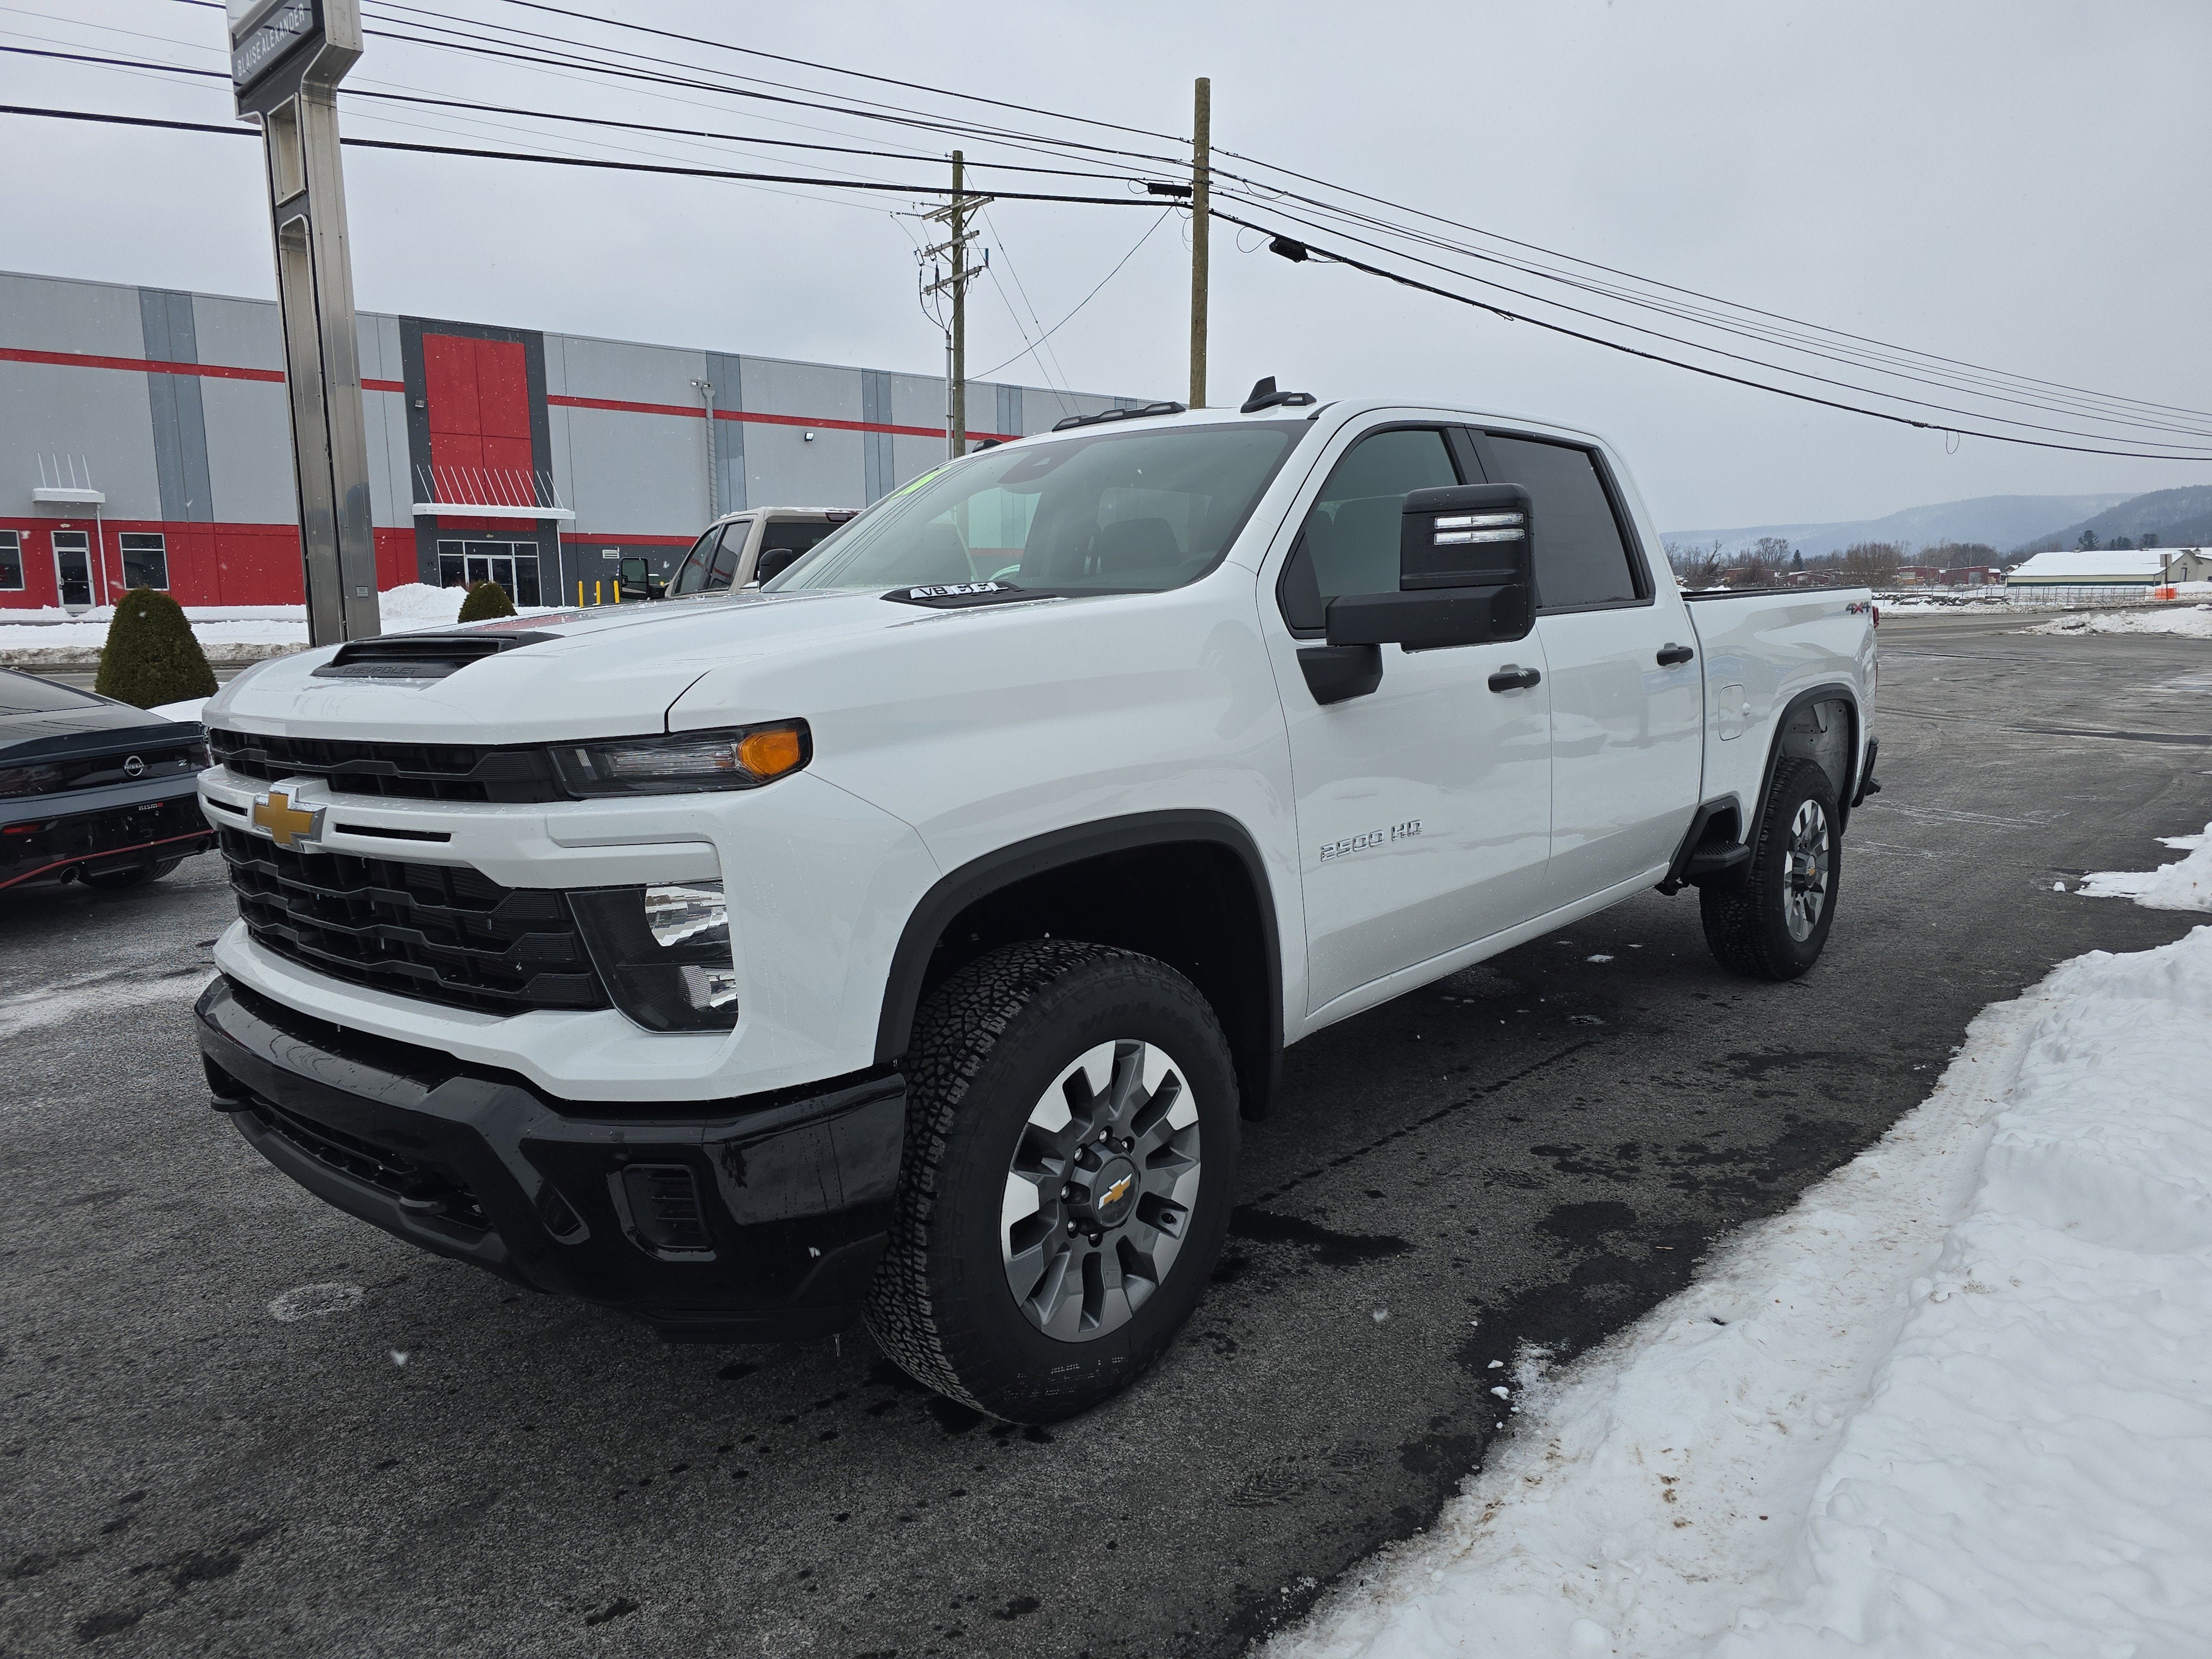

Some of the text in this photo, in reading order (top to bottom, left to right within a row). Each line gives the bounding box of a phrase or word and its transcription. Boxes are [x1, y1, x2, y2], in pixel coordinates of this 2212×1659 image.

[237, 3, 305, 77] BLAISE ALEXANDER
[919, 587, 948, 595] V8
[1320, 819, 1423, 862] 2500 HD
